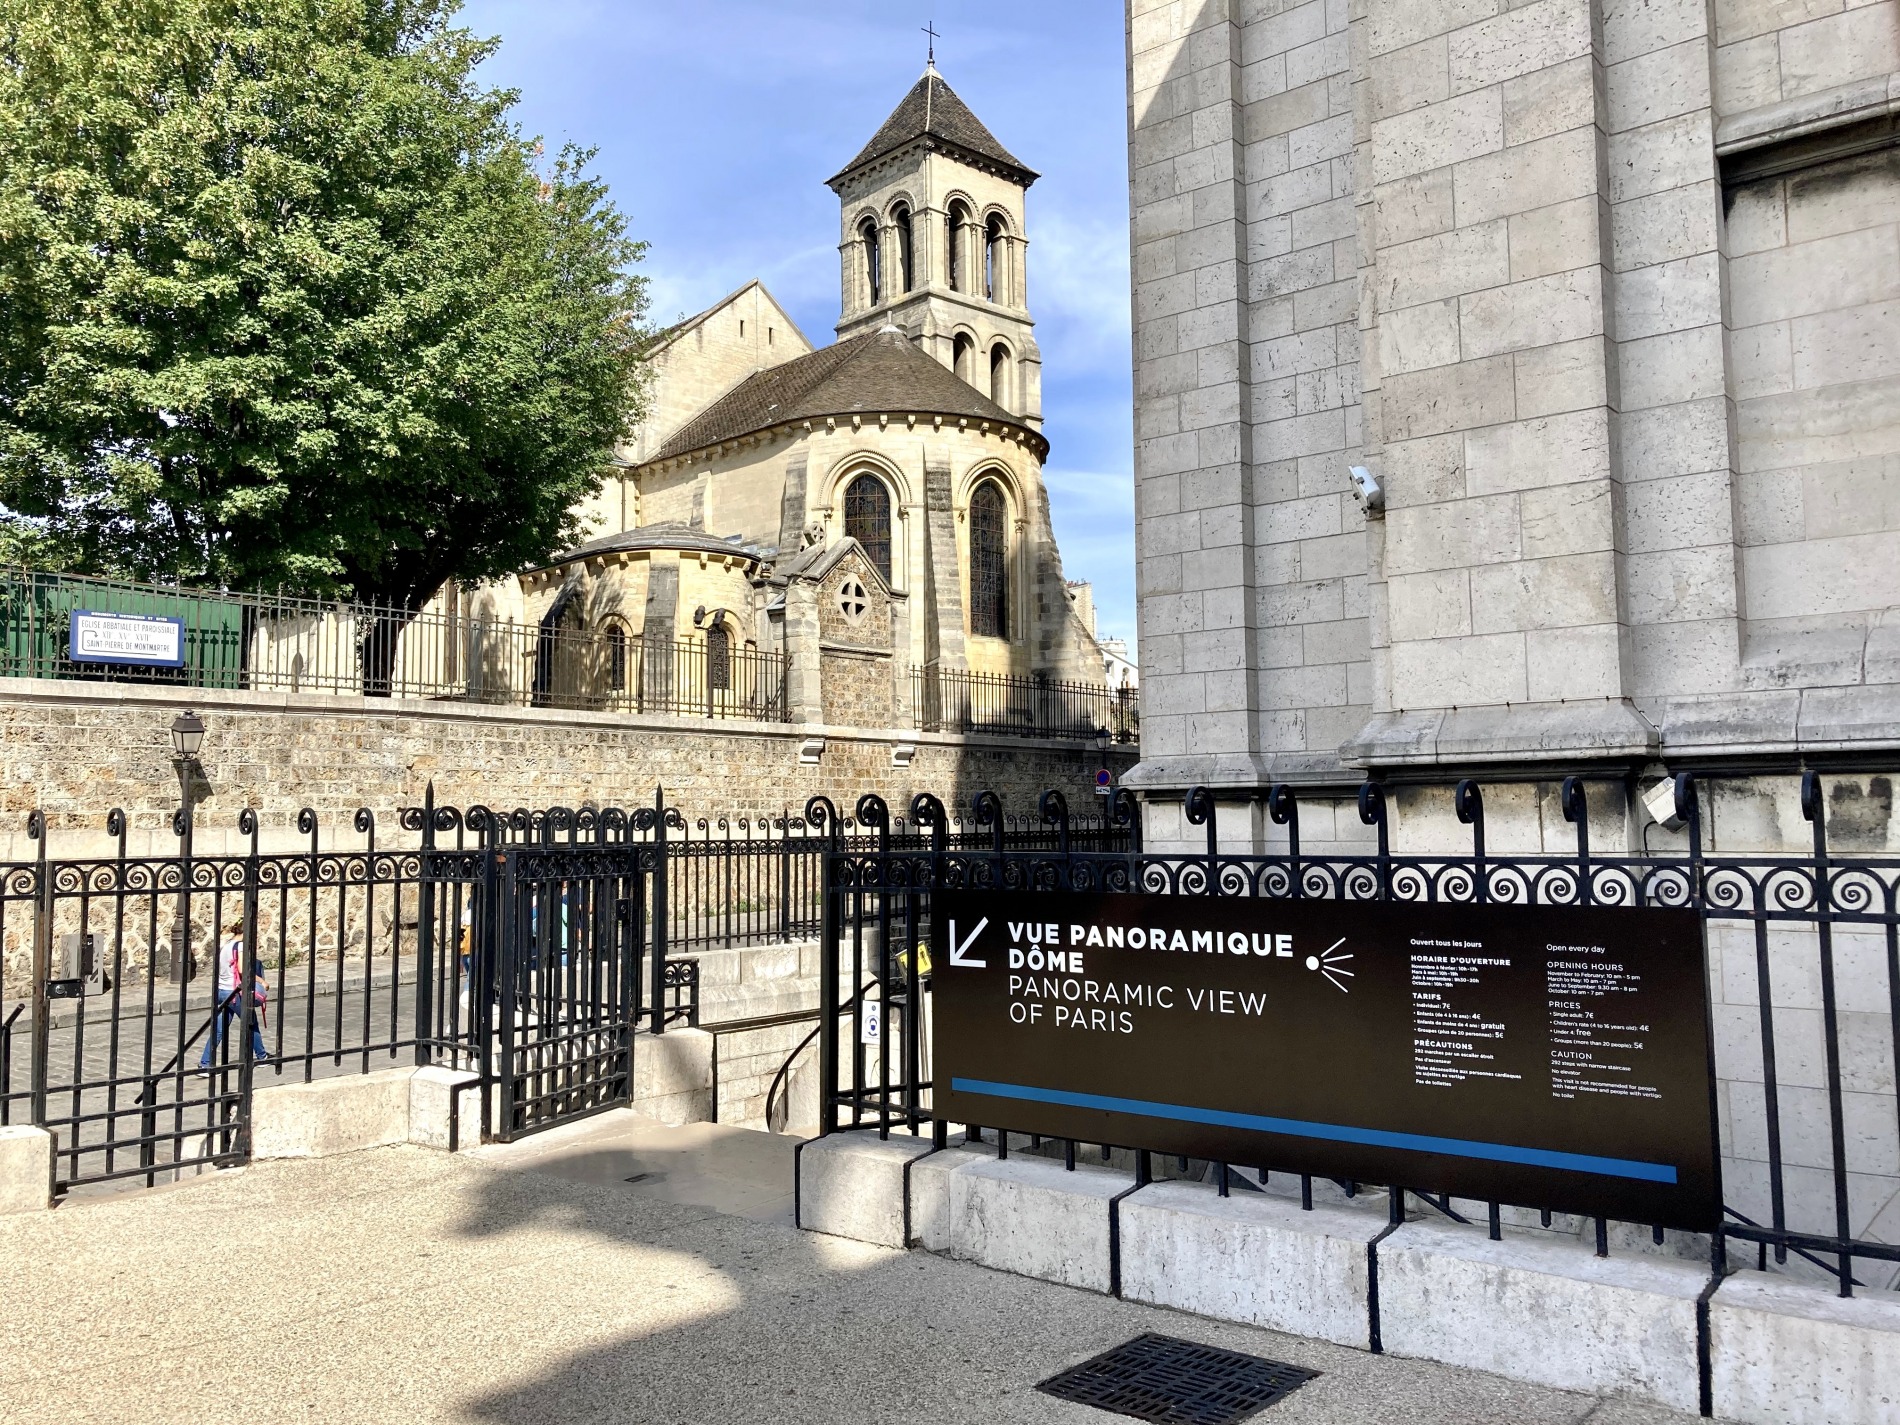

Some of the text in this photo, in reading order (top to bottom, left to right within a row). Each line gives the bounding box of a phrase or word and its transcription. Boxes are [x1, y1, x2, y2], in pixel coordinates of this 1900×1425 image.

[82, 620, 100, 628] EGLISE
[103, 621, 131, 631] ABBATIALE
[142, 624, 175, 634] PAROISSIALE
[134, 642, 170, 652] MONTMARTRE
[1008, 922, 1294, 958] VUE PANORAMIQUE
[1464, 940, 1482, 948] jours
[1546, 944, 1567, 952] Open
[1591, 946, 1605, 954] day
[1009, 944, 1084, 974] DÔME
[1411, 955, 1511, 966] HORAIRE D'OUVERTURE
[1009, 975, 1266, 1016] PANORAMIC VIEW
[1412, 992, 1441, 1000] TARIFS
[1549, 1001, 1580, 1009] PRICES
[1009, 1002, 1133, 1034] OF PARIS
[1584, 1011, 1594, 1019] 7€
[1480, 1022, 1505, 1030] gratuit
[1576, 1028, 1591, 1036] free
[1414, 1039, 1473, 1050] PRÉCAUTIONS
[1551, 1051, 1592, 1060] CAUTION
